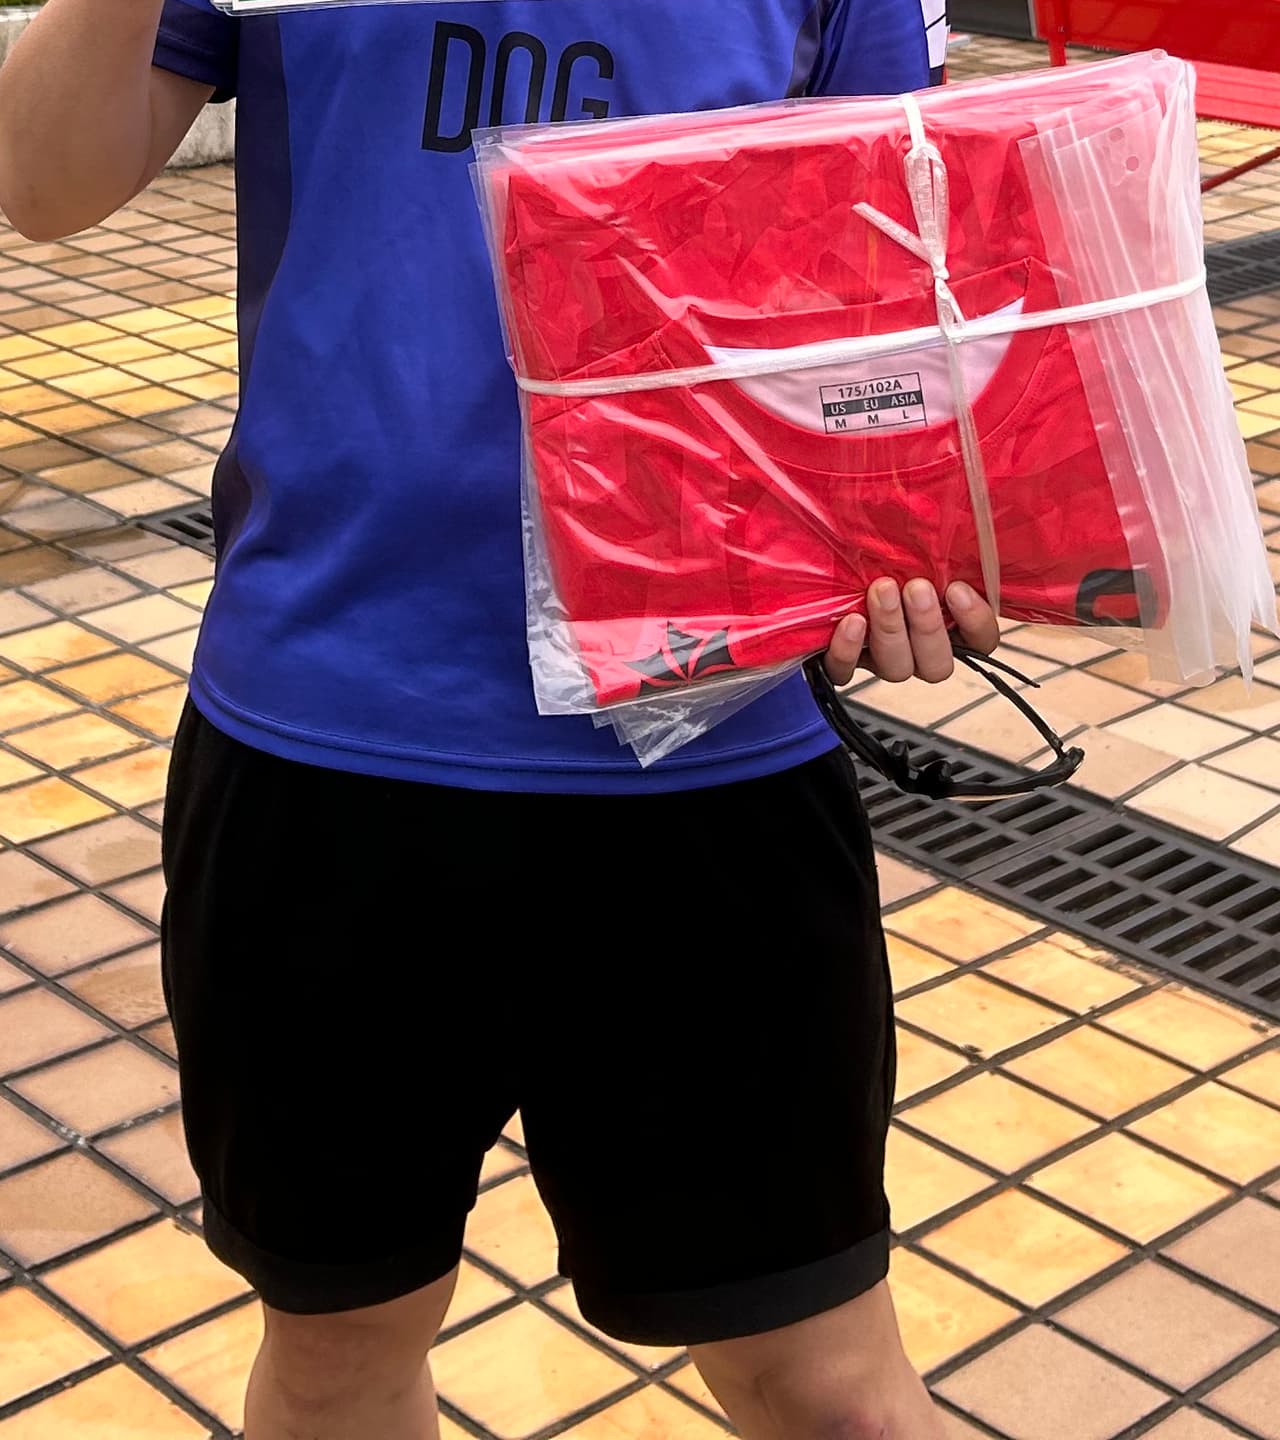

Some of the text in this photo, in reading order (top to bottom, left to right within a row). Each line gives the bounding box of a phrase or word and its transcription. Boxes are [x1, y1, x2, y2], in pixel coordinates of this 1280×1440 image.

[838, 379, 902, 398] 175/102A
[830, 393, 918, 415] US EU ASIA
[835, 409, 910, 429] M M L
